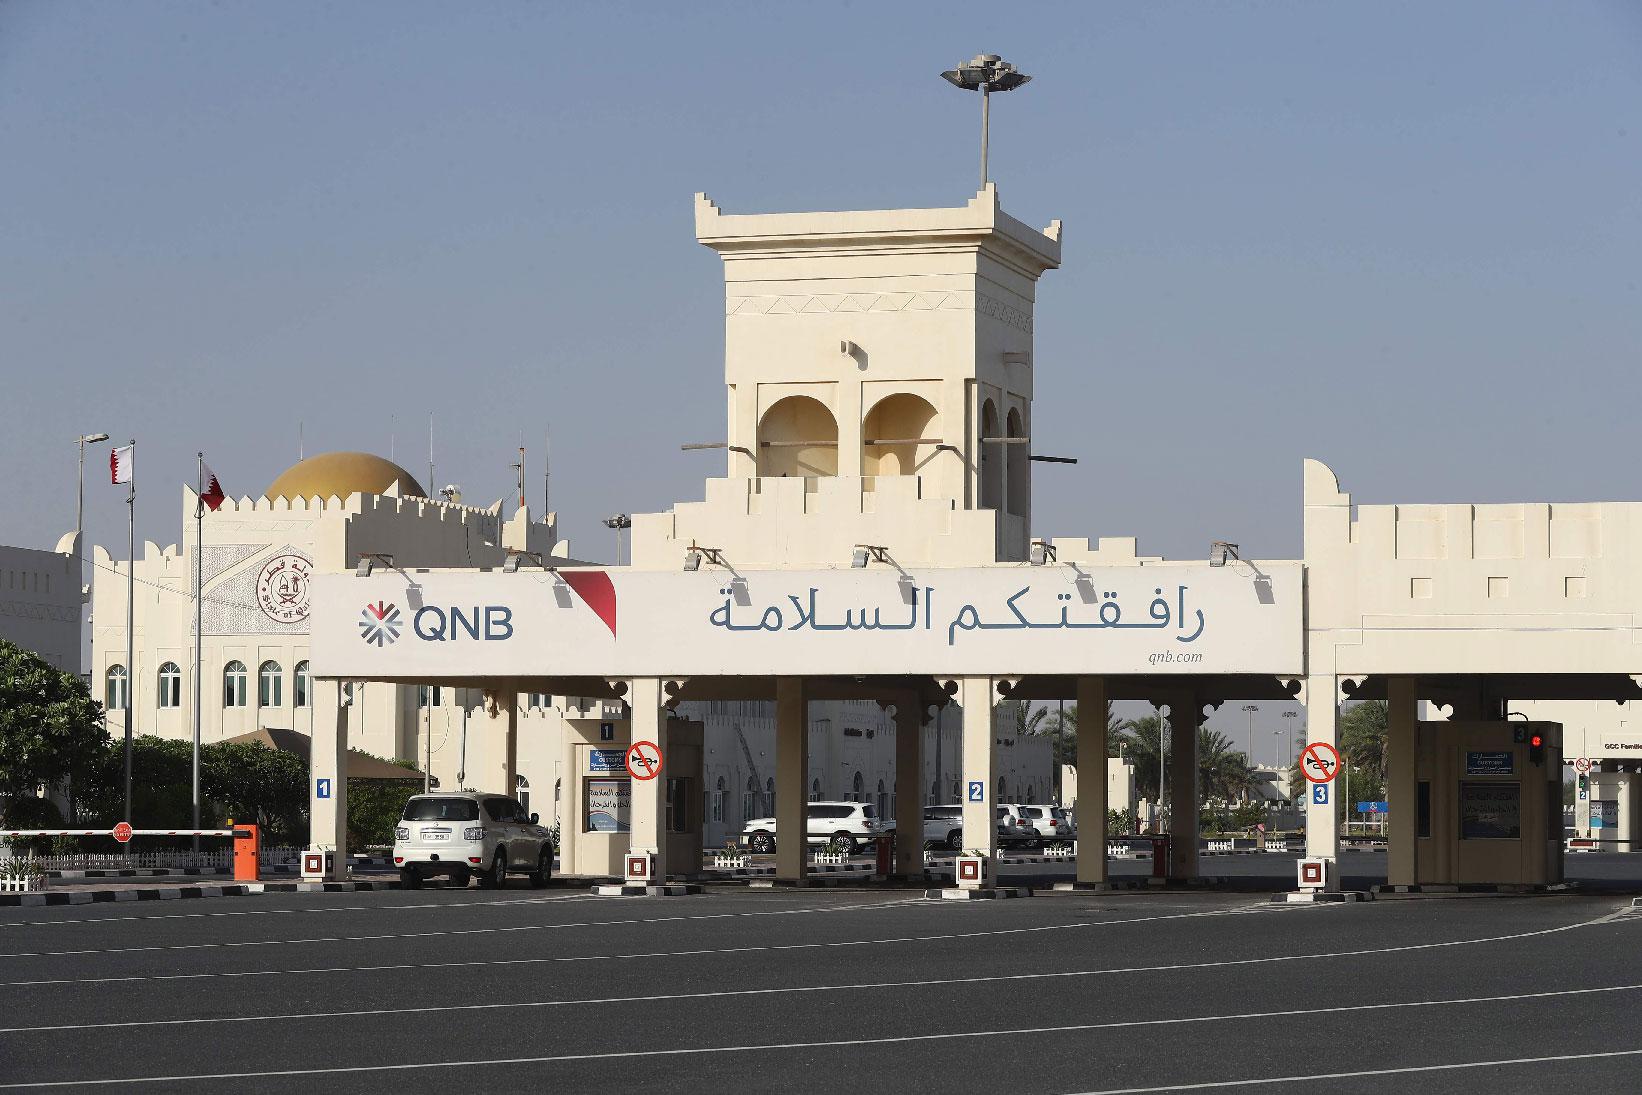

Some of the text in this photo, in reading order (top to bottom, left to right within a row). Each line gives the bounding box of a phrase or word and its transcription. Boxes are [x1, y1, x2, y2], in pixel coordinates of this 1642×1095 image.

[413, 606, 514, 641] QNB
[709, 586, 1205, 646] رافقتكم السلامة
[1148, 649, 1203, 666] qnb.com
[604, 725, 609, 739] 1
[319, 781, 328, 796] 1
[971, 783, 981, 800] 2
[1315, 786, 1326, 803] 3
[1580, 791, 1586, 799] 2
